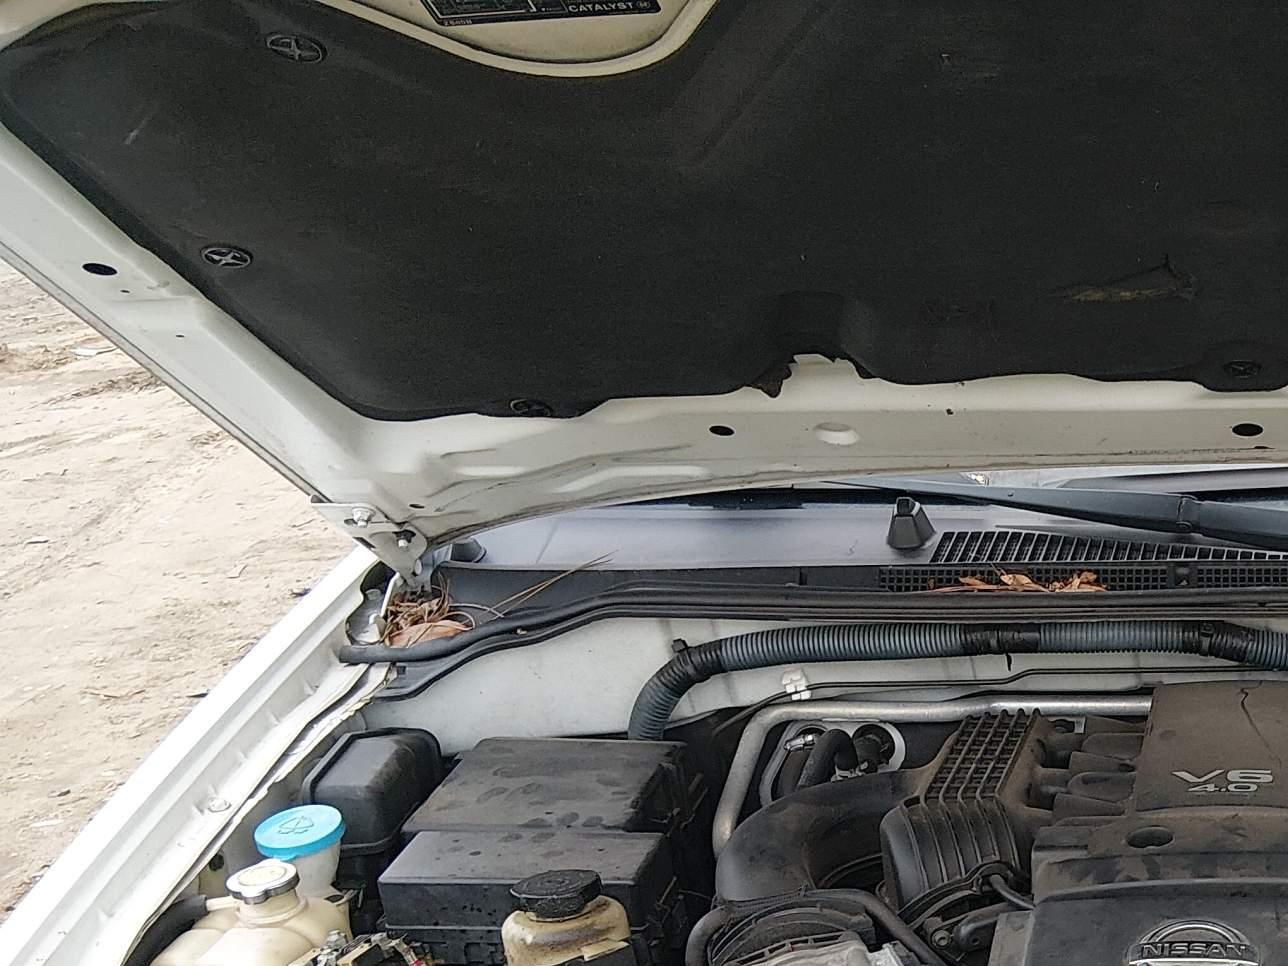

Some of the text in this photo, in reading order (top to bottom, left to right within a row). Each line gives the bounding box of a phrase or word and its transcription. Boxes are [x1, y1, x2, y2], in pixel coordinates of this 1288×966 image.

[568, 1, 634, 13] CATALYST
[1171, 768, 1274, 783] V6
[1187, 782, 1258, 793] 4.0
[1142, 942, 1248, 958] NISSAN
